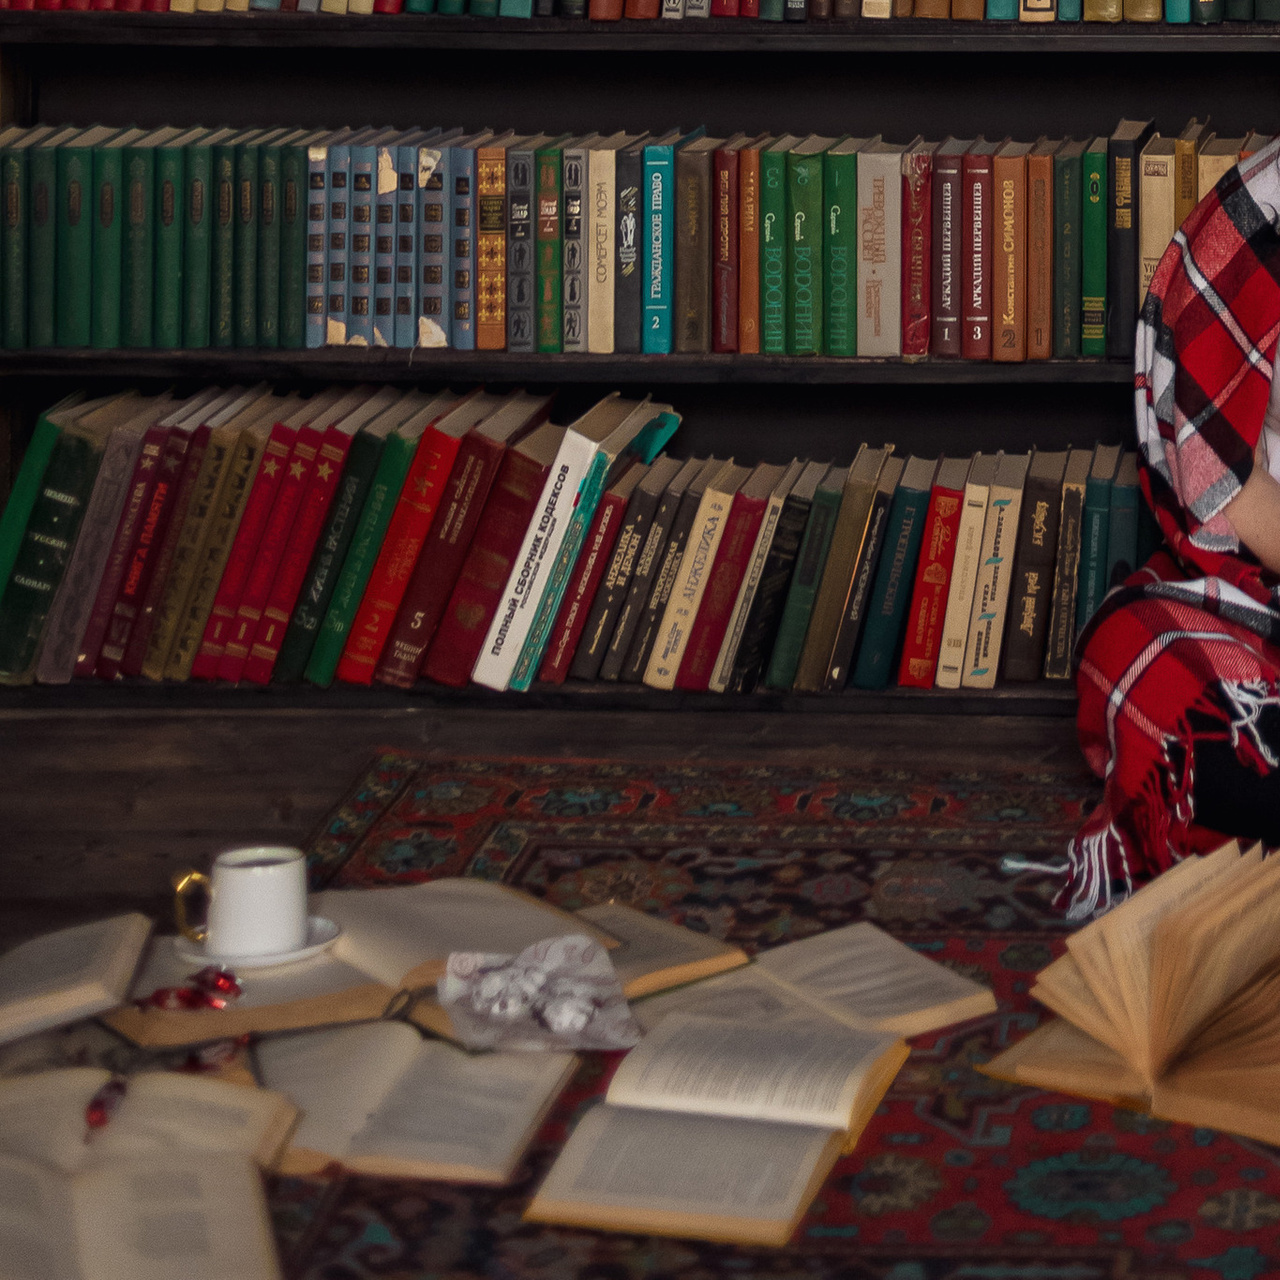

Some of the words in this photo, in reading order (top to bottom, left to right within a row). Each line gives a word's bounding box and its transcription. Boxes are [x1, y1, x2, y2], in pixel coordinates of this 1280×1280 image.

[596, 182, 607, 219] МОЭМ
[652, 173, 662, 210] ПРАВО
[940, 182, 952, 251] ПЕРВЕНЦЕВ
[1002, 179, 1016, 251] СИМОНОВ
[595, 223, 608, 285] СОМЕРСЕТ
[651, 213, 663, 299] ГРАЖДАНСКОЕ
[941, 253, 952, 310] АРКАДИЙ
[765, 246, 784, 350] ВОРОНИН
[1003, 254, 1016, 325] Константин
[490, 596, 517, 656] ПОЛНЫЙ
[513, 534, 544, 595] СБОРНИК
[537, 464, 570, 533] КОДЕКСОВ
[603, 523, 632, 590] АНЖЕЛИКА
